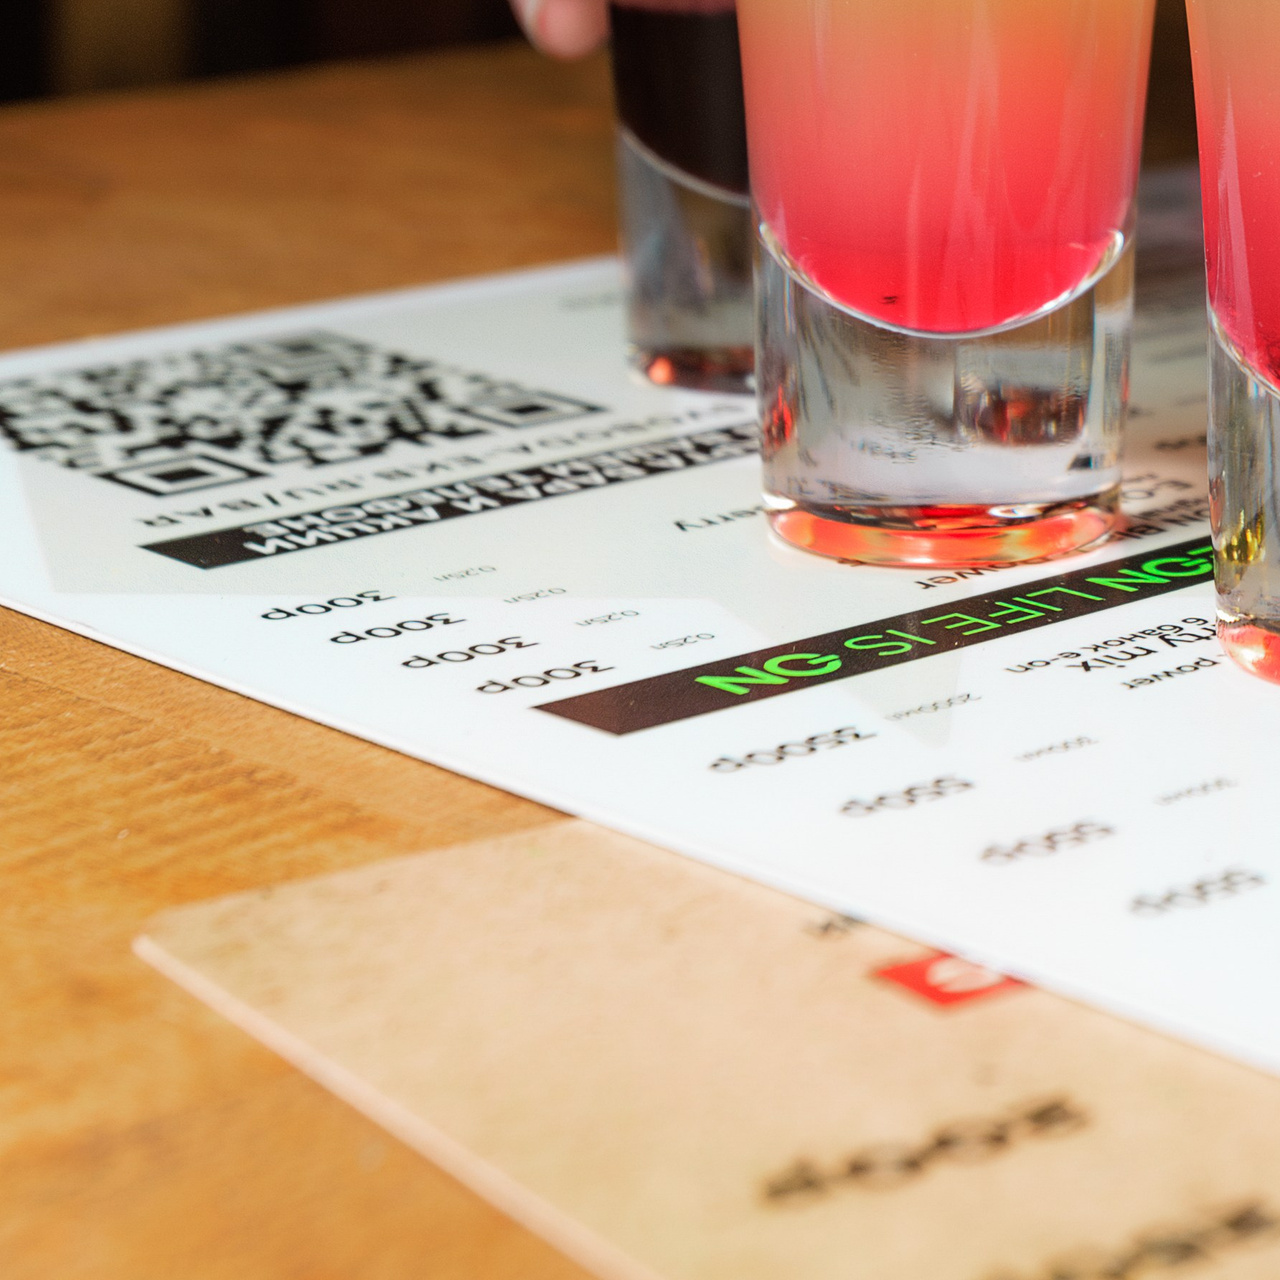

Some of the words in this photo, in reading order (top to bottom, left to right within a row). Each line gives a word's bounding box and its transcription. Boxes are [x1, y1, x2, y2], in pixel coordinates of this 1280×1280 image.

[242, 505, 441, 556] АКЦИИ
[672, 505, 764, 536] erry
[260, 589, 396, 623] 300р
[922, 586, 1105, 637] LIFE
[329, 613, 468, 647] 300р
[844, 630, 935, 656] IS
[1080, 625, 1183, 652] банок
[400, 636, 539, 671] 300р
[1004, 652, 1078, 677] e-on
[1066, 646, 1158, 673] mix
[474, 659, 616, 696] 300р
[694, 652, 842, 696] ON
[1121, 657, 1220, 690] power
